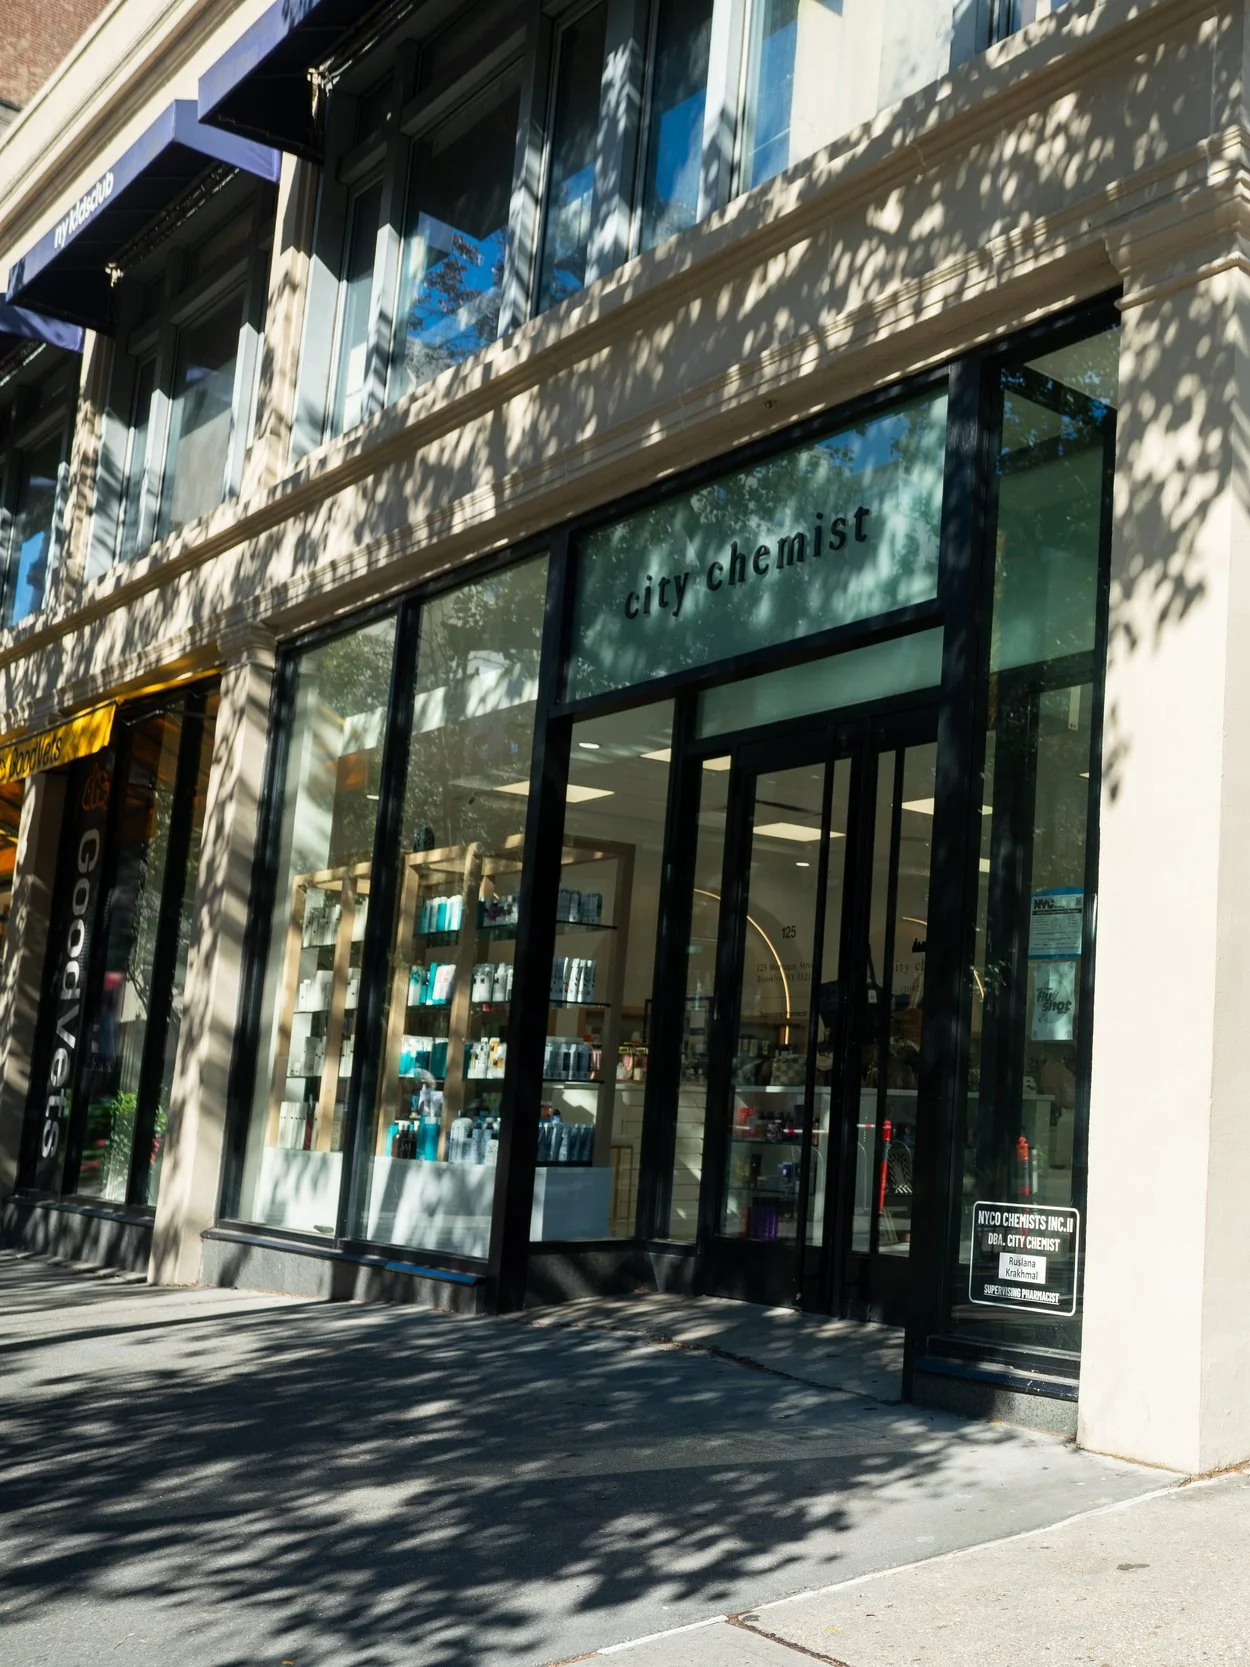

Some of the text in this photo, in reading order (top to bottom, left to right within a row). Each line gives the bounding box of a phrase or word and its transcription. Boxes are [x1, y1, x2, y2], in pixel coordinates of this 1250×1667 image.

[68, 171, 114, 235] kidsclub
[624, 506, 870, 620] city chemist
[9, 736, 62, 779] GoodVets
[782, 925, 797, 939] 125
[42, 827, 100, 1160] GoodVets
[978, 1210, 1001, 1226] NYCO
[1002, 1212, 1046, 1230] CHEMISTS
[1007, 1234, 1026, 1248] CITY
[1026, 1235, 1060, 1252] CHEMIST
[1009, 1256, 1036, 1268] Ruslana
[1005, 1268, 1038, 1281] Krakhmal
[983, 1284, 1060, 1304] SUPERVISING PHARMACIST
